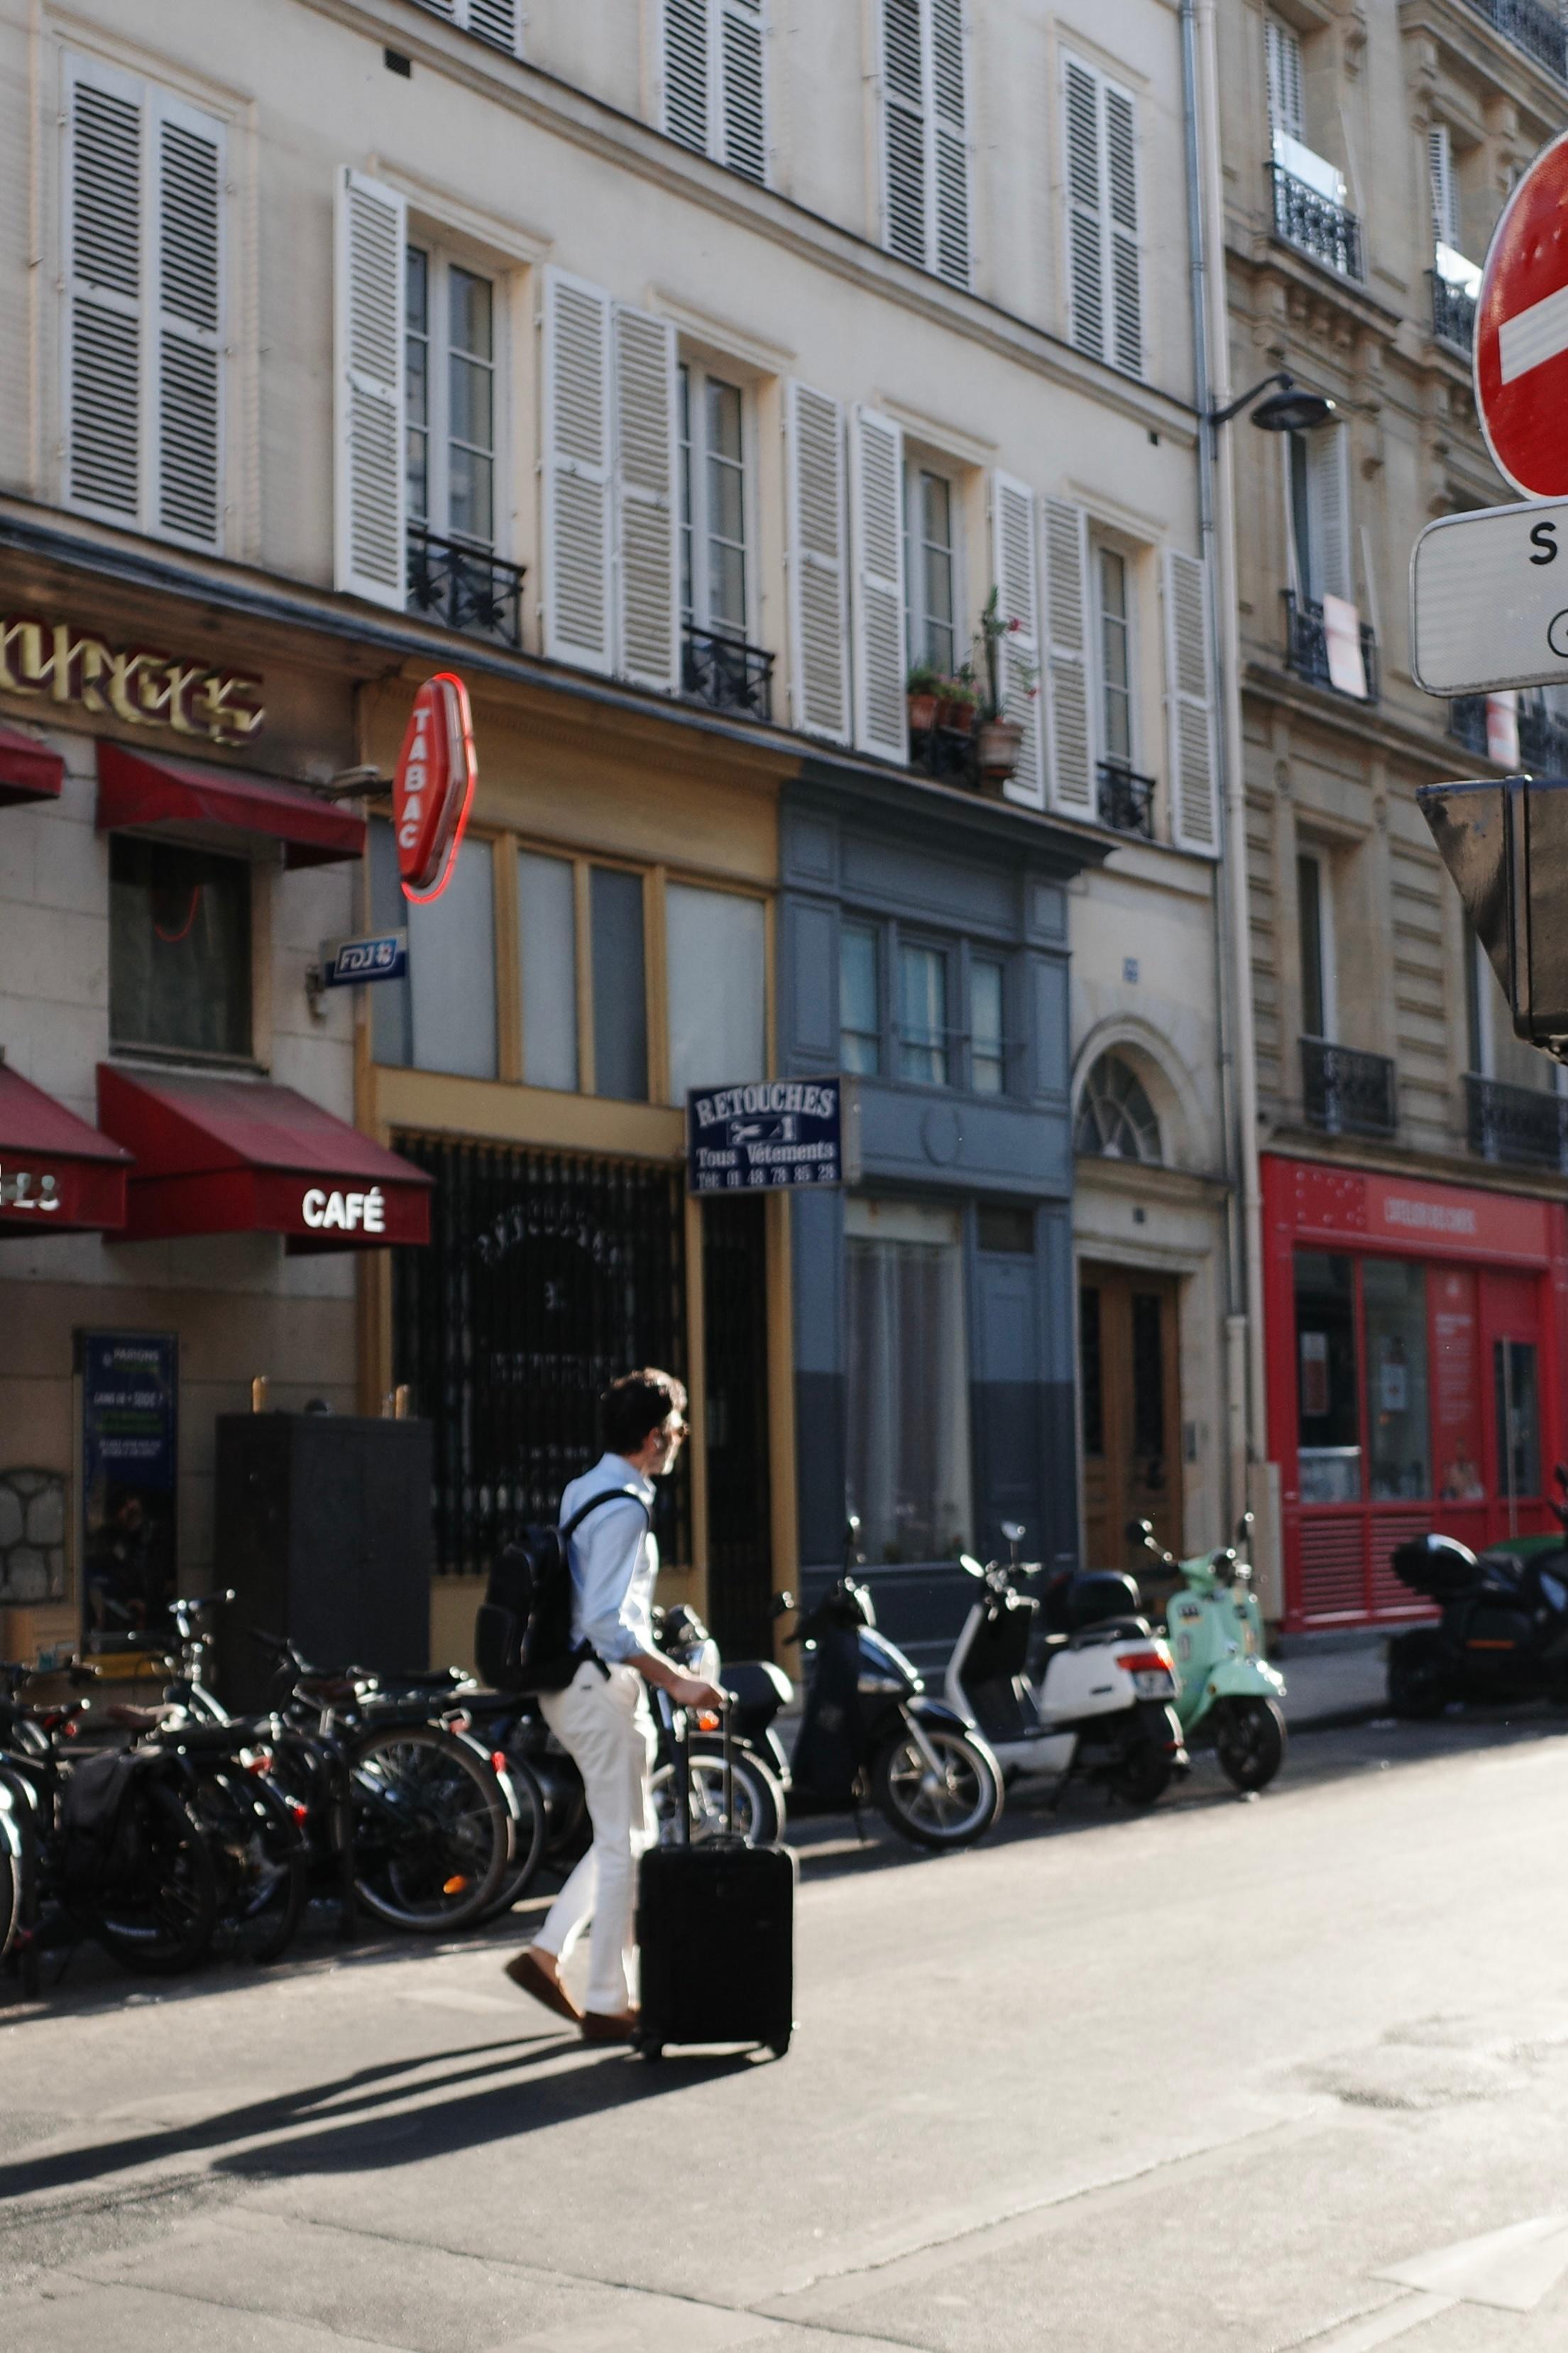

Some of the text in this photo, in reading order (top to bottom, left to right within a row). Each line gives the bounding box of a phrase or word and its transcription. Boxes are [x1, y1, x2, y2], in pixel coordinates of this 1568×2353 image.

[399, 707, 432, 848] TABAC
[339, 945, 376, 971] FDJ
[696, 1083, 835, 1128] RETOUCHES
[696, 1147, 737, 1167] Tous
[302, 1186, 385, 1233] CAFÉ
